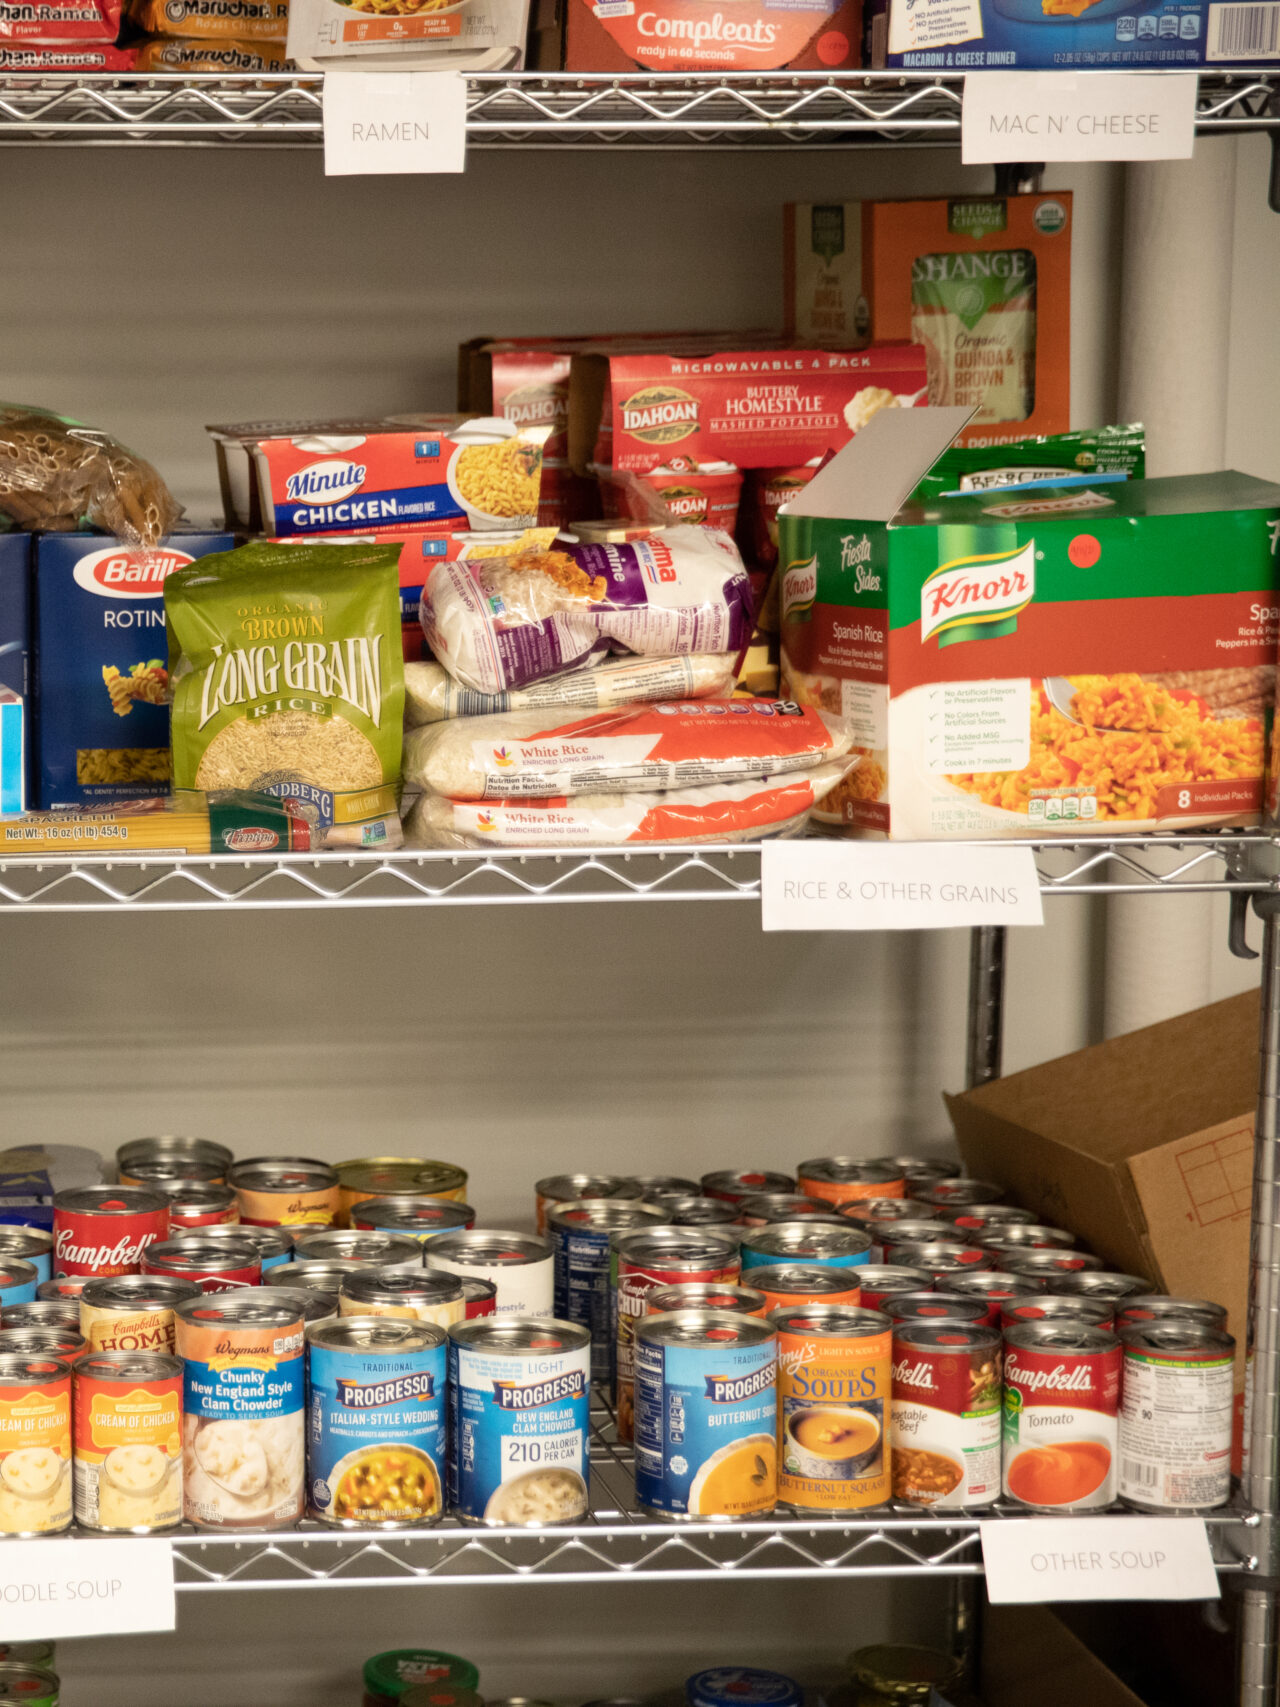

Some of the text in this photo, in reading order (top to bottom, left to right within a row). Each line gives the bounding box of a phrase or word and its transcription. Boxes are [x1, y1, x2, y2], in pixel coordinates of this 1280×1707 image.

[40, 6, 103, 21] Ramen
[636, 12, 777, 47] Compleats
[636, 44, 735, 60] ready in 60 seconds
[903, 51, 1016, 67] MACARONI & CHEESE DINNER
[352, 121, 430, 142] RAMEN
[989, 114, 1160, 135] MAC CHEESE
[671, 357, 872, 375] MICROWAVABLE PACK
[725, 394, 823, 415] HOMESTYLE
[622, 400, 699, 431] IDAHOAN
[710, 418, 765, 431] MASHED
[285, 462, 367, 503] Minute
[292, 498, 436, 527] CHICKEN FLAVORED RICE
[925, 570, 1030, 618] Knorr
[241, 614, 325, 641] BROWN
[1238, 626, 1255, 636] Rice
[1215, 638, 1248, 650] Peppers
[198, 633, 385, 734] LONG GRAIN
[956, 686, 1017, 697] Artificial Flavors
[253, 698, 327, 718] RICE
[956, 709, 1000, 720] Colors From
[956, 732, 1000, 742] Added MSG
[519, 742, 590, 760] White Rice
[944, 756, 1012, 768] Cooks minutes
[1177, 790, 1254, 809] 8 Individual Packs
[545, 812, 575, 825] Rice
[5, 825, 118, 839] Net 16 454
[783, 880, 1019, 905] RICE & OTHER GRAINS
[214, 1340, 271, 1360] Wegmans
[819, 1347, 842, 1358] LIGHT
[362, 1362, 414, 1374] TRADITIONAL
[528, 1359, 565, 1375] LIGHT
[811, 1367, 858, 1378] ORGANIC
[1003, 1353, 1093, 1393] Campbell's
[219, 1370, 266, 1386] Chunky
[792, 1366, 877, 1400] SOUPS
[191, 1380, 293, 1400] New England Style
[343, 1374, 430, 1408] PROGRESSO
[502, 1371, 582, 1408] PROGRESSO
[201, 1396, 284, 1412] Clam Chowder
[24, 1417, 36, 1432] OF
[95, 1410, 177, 1430] CREAM OF CHICKEN
[402, 1409, 440, 1426] WEDDING
[516, 1407, 574, 1424] NEW ENGLAND
[708, 1410, 762, 1428] BUTTERNUT
[1026, 1413, 1075, 1429] Tomato
[512, 1418, 577, 1434] CLAM CHOWDER
[899, 1421, 920, 1435] Beef
[508, 1436, 580, 1463] 210 CALORIES
[544, 1449, 575, 1462] PER CAN
[1030, 1551, 1167, 1573] OTHER SOUP
[66, 1578, 122, 1601] SOUP
